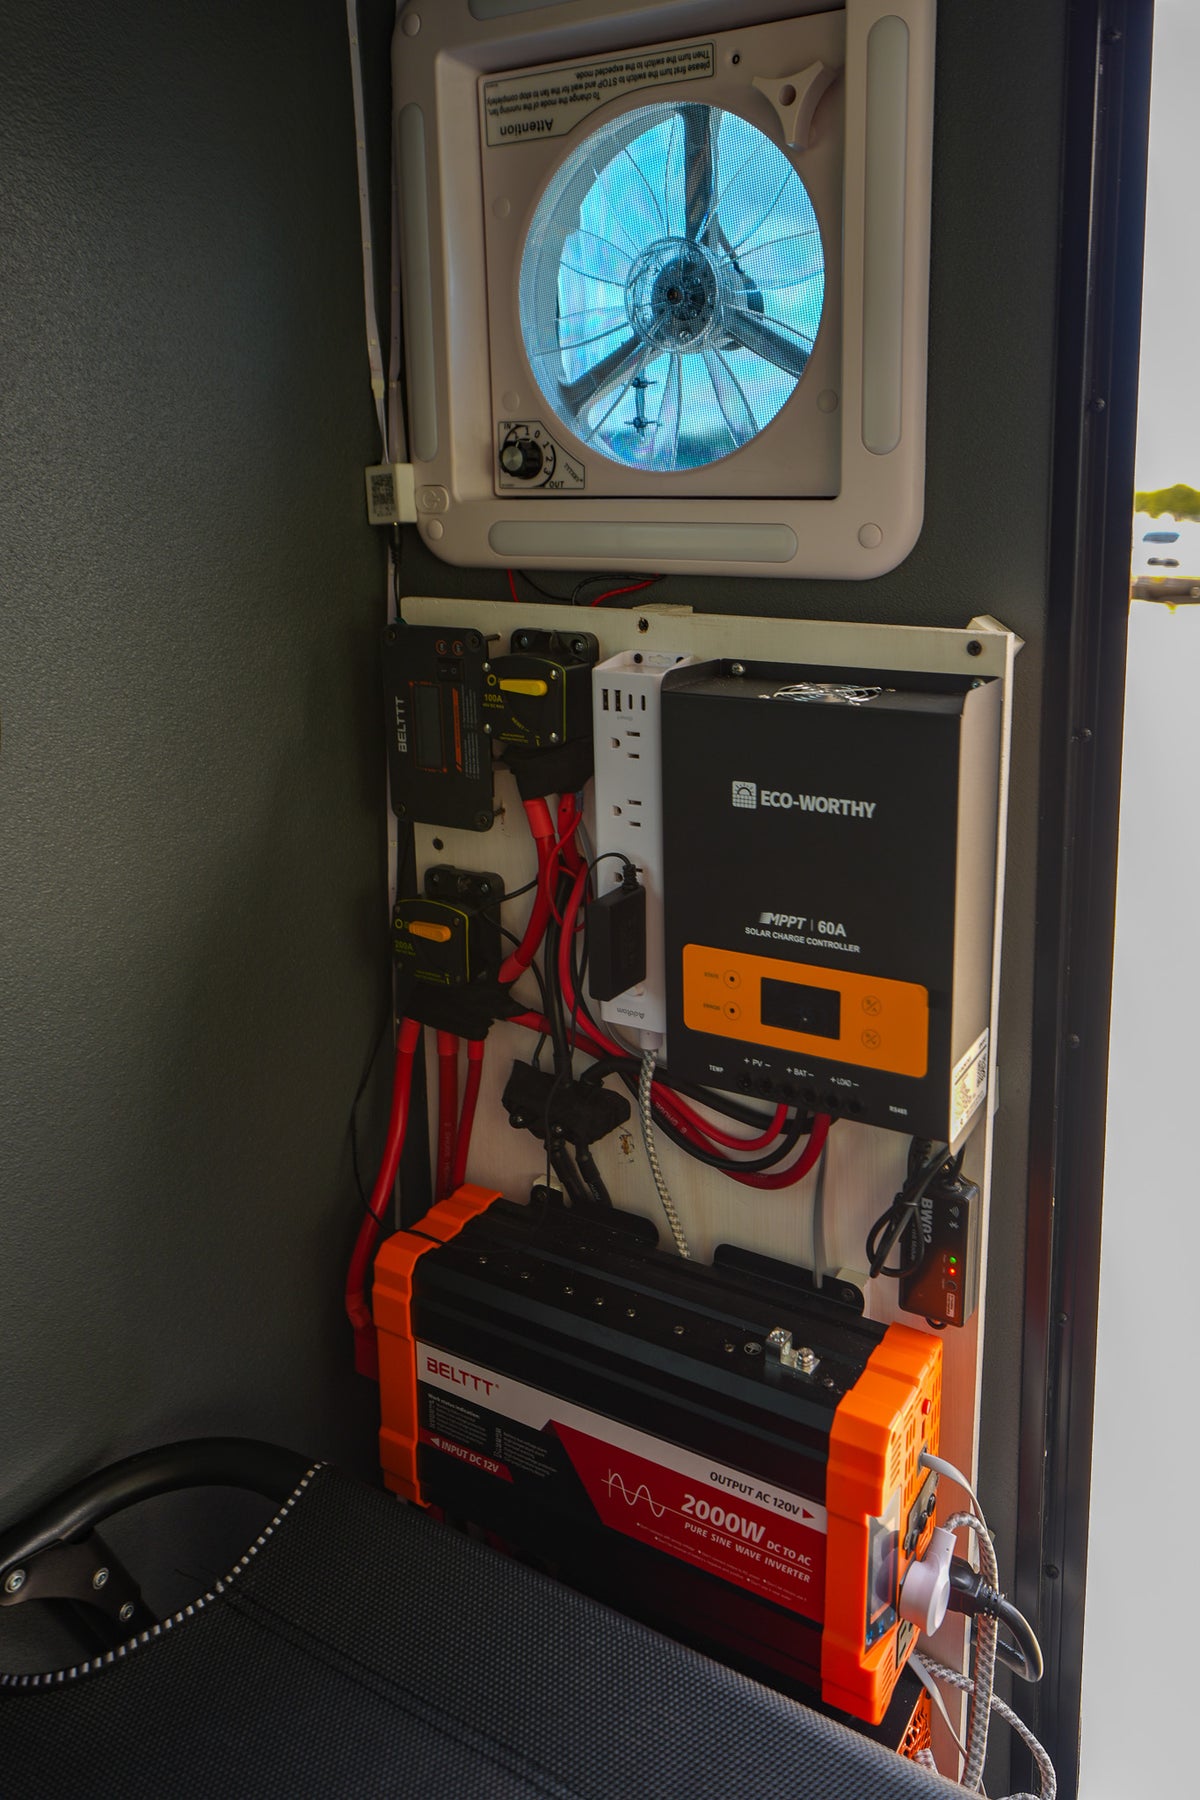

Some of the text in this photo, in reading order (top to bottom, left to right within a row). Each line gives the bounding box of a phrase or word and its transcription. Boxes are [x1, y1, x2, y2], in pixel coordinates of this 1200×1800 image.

[666, 55, 677, 63] the
[678, 53, 691, 61] turn
[693, 50, 710, 58] Then
[625, 62, 635, 70] the
[644, 57, 665, 68] switch
[688, 60, 711, 72] please
[595, 65, 623, 77] expected
[648, 70, 658, 79] the
[659, 68, 673, 76] turn
[674, 65, 686, 74] first
[618, 76, 625, 84] to
[626, 72, 646, 82] switch
[597, 77, 617, 88] STOP
[540, 89, 550, 97] fan
[550, 87, 560, 95] the
[561, 86, 570, 94] for
[571, 84, 583, 92] wait
[558, 96, 568, 104] the
[569, 94, 592, 103] change
[592, 91, 600, 100] To
[523, 102, 533, 110] the
[533, 102, 539, 110] of
[540, 98, 557, 107] mode
[500, 104, 522, 114] running
[500, 118, 553, 136] Attention
[484, 693, 503, 703] 100A
[395, 696, 408, 752] BELTTT
[760, 790, 876, 819] ECO-WORTHY
[766, 912, 847, 937] MPPT 60A
[745, 926, 860, 953] SOLAR CHARGE CONTROLLER
[752, 1058, 763, 1068] PV
[709, 1064, 724, 1073] TEMP
[793, 1068, 808, 1078] BAT
[836, 1077, 852, 1088] LOAD
[427, 1356, 494, 1396] BELTTT
[441, 1441, 499, 1473] INPUT DC 12V
[709, 1471, 800, 1515] OUTPUT AC 120V
[681, 1493, 766, 1544] 2000W
[767, 1540, 780, 1553] DC
[782, 1546, 796, 1559] TO
[797, 1554, 812, 1566] AC
[684, 1522, 708, 1538] PURE
[711, 1533, 733, 1549] SINE
[735, 1544, 762, 1561] WAVE
[764, 1557, 811, 1584] INVERTER
